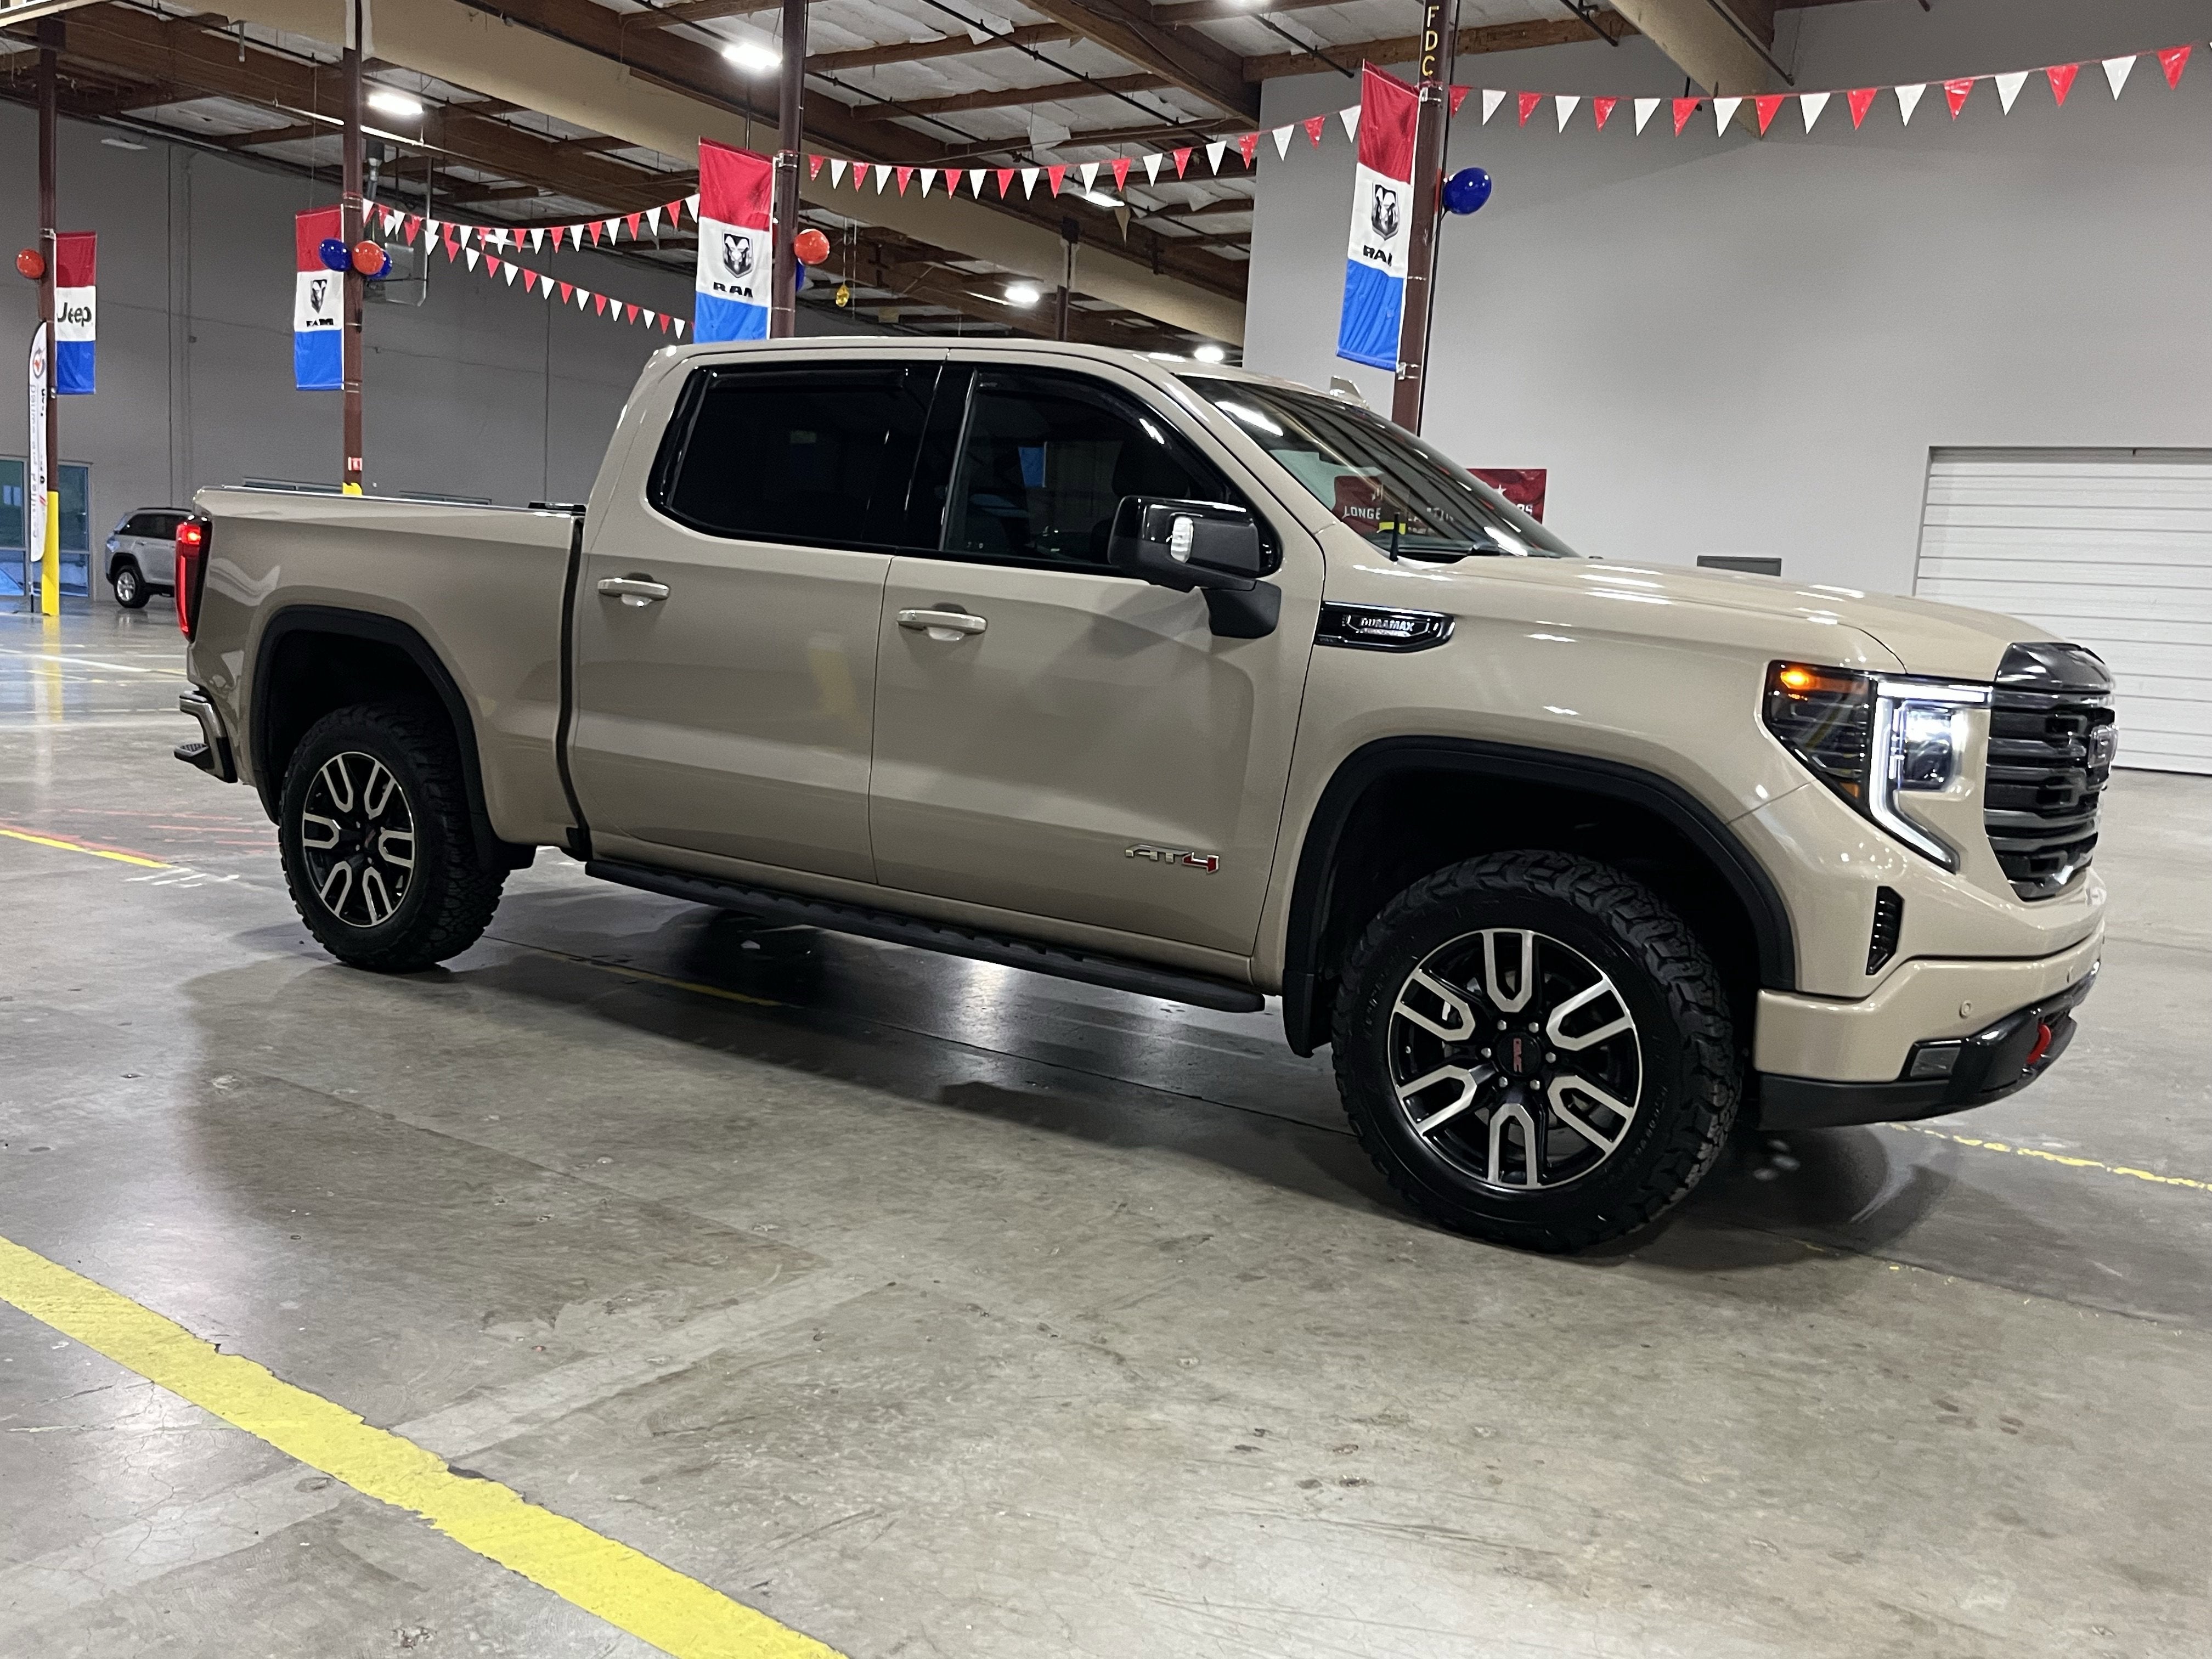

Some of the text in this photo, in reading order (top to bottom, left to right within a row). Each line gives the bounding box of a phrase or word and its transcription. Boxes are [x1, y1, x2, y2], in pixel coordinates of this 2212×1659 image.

[57, 302, 92, 327] Jeep
[1360, 618, 1415, 631] DURAMAX
[1125, 843, 1219, 873] AT4
